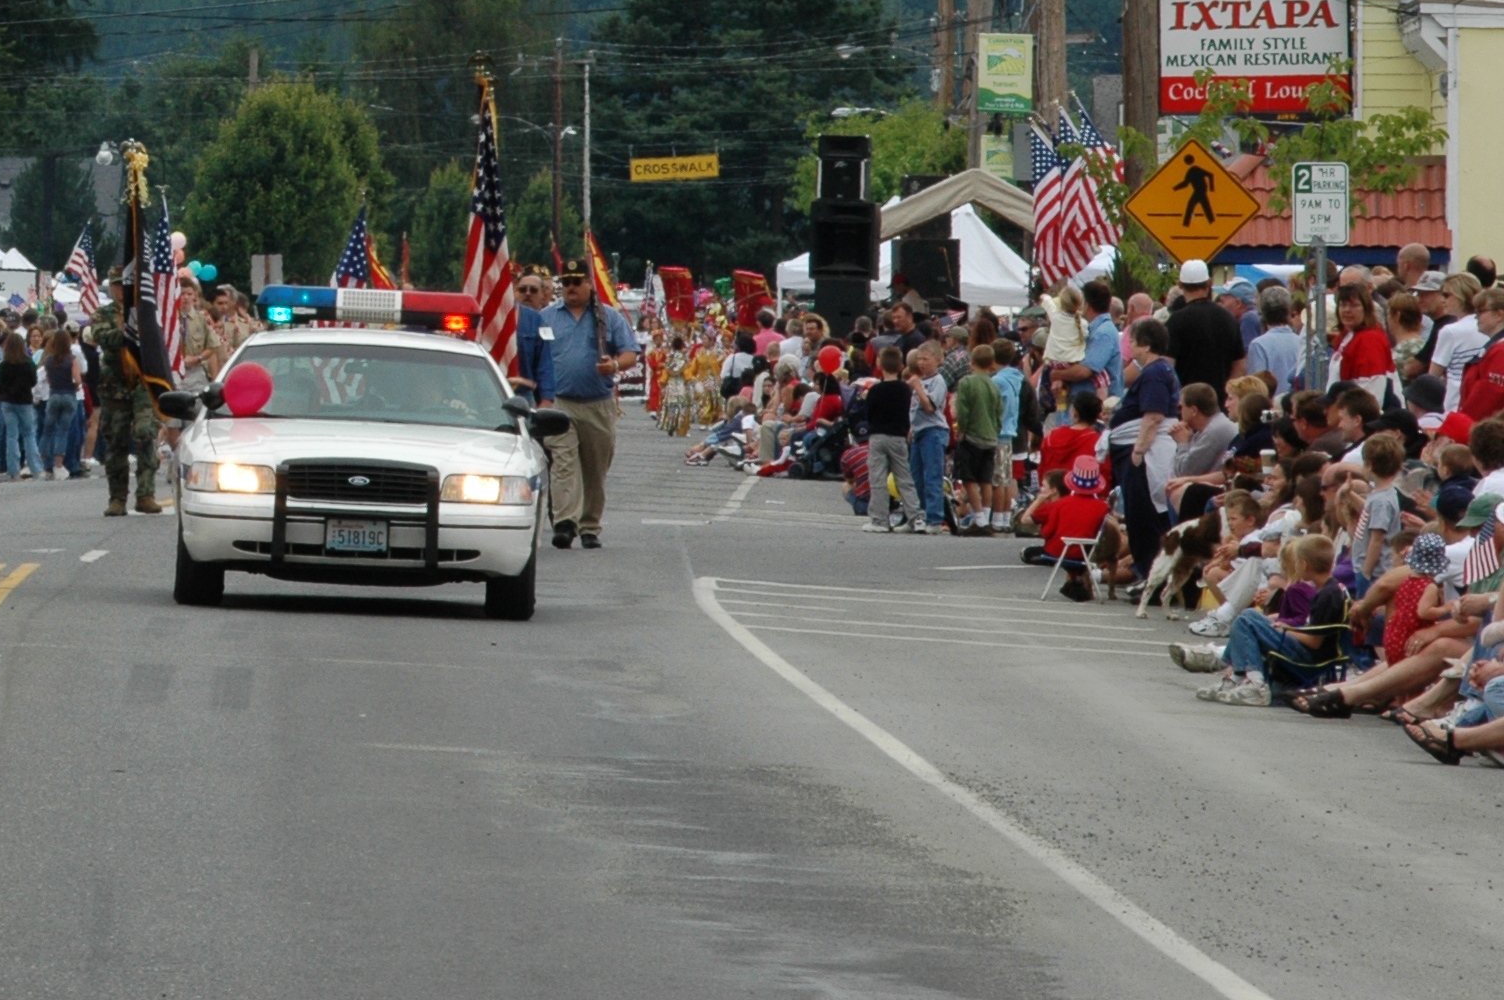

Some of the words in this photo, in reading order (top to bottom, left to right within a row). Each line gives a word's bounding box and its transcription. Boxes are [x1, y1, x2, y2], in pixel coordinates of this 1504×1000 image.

[1200, 37, 1256, 51] FAMILY
[1262, 36, 1308, 50] STYLE
[1166, 53, 1237, 68] MEXICAN
[634, 161, 714, 176] CROSSWALK
[1297, 168, 1310, 190] 2
[1313, 180, 1345, 191] PARKING
[1300, 198, 1322, 209] 9AM
[1328, 198, 1341, 209] TO
[1309, 214, 1331, 224] 5PM
[337, 529, 384, 545] 51819C
